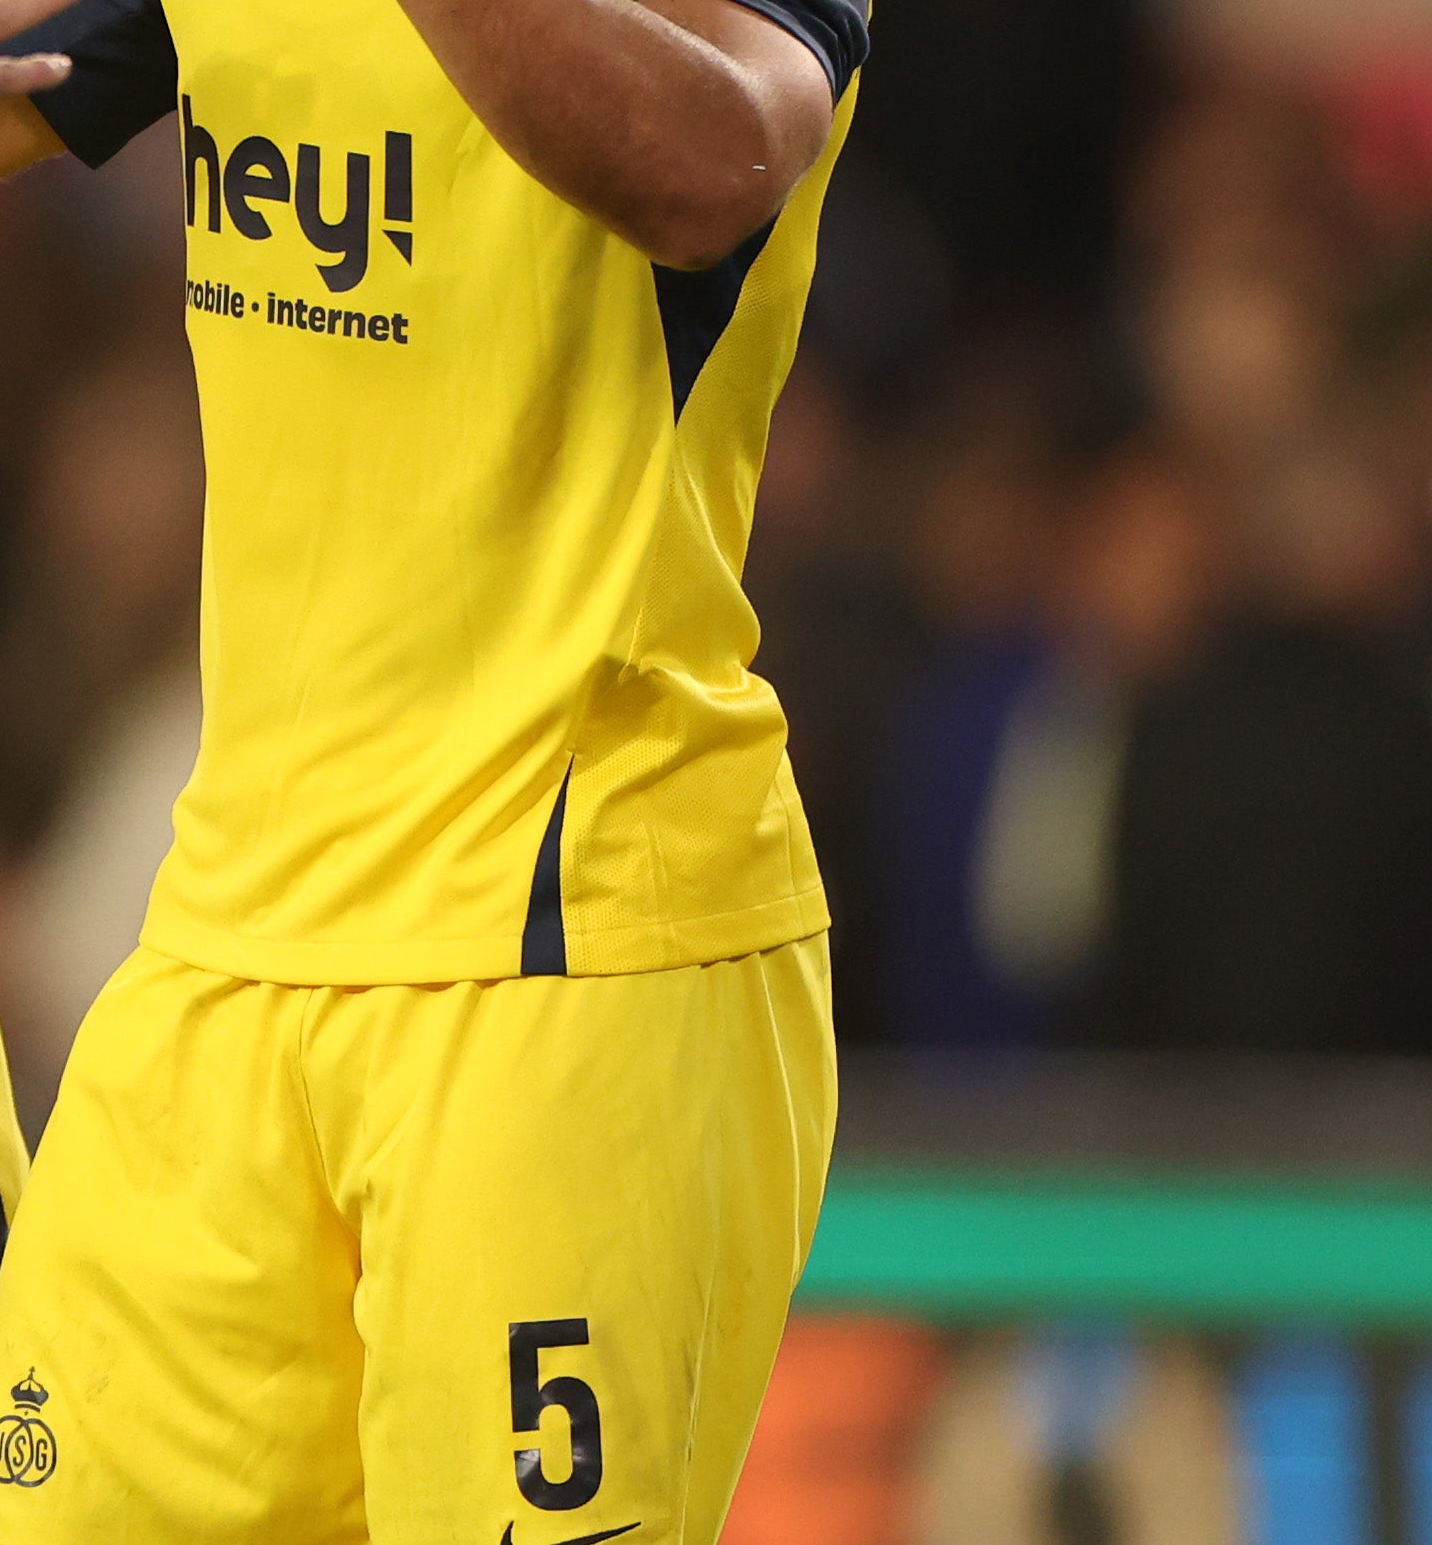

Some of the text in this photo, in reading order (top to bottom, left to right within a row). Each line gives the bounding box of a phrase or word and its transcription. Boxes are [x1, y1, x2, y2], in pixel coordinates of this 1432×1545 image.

[181, 93, 412, 293] hey!
[267, 292, 409, 344] internet
[509, 1318, 602, 1511] 5
